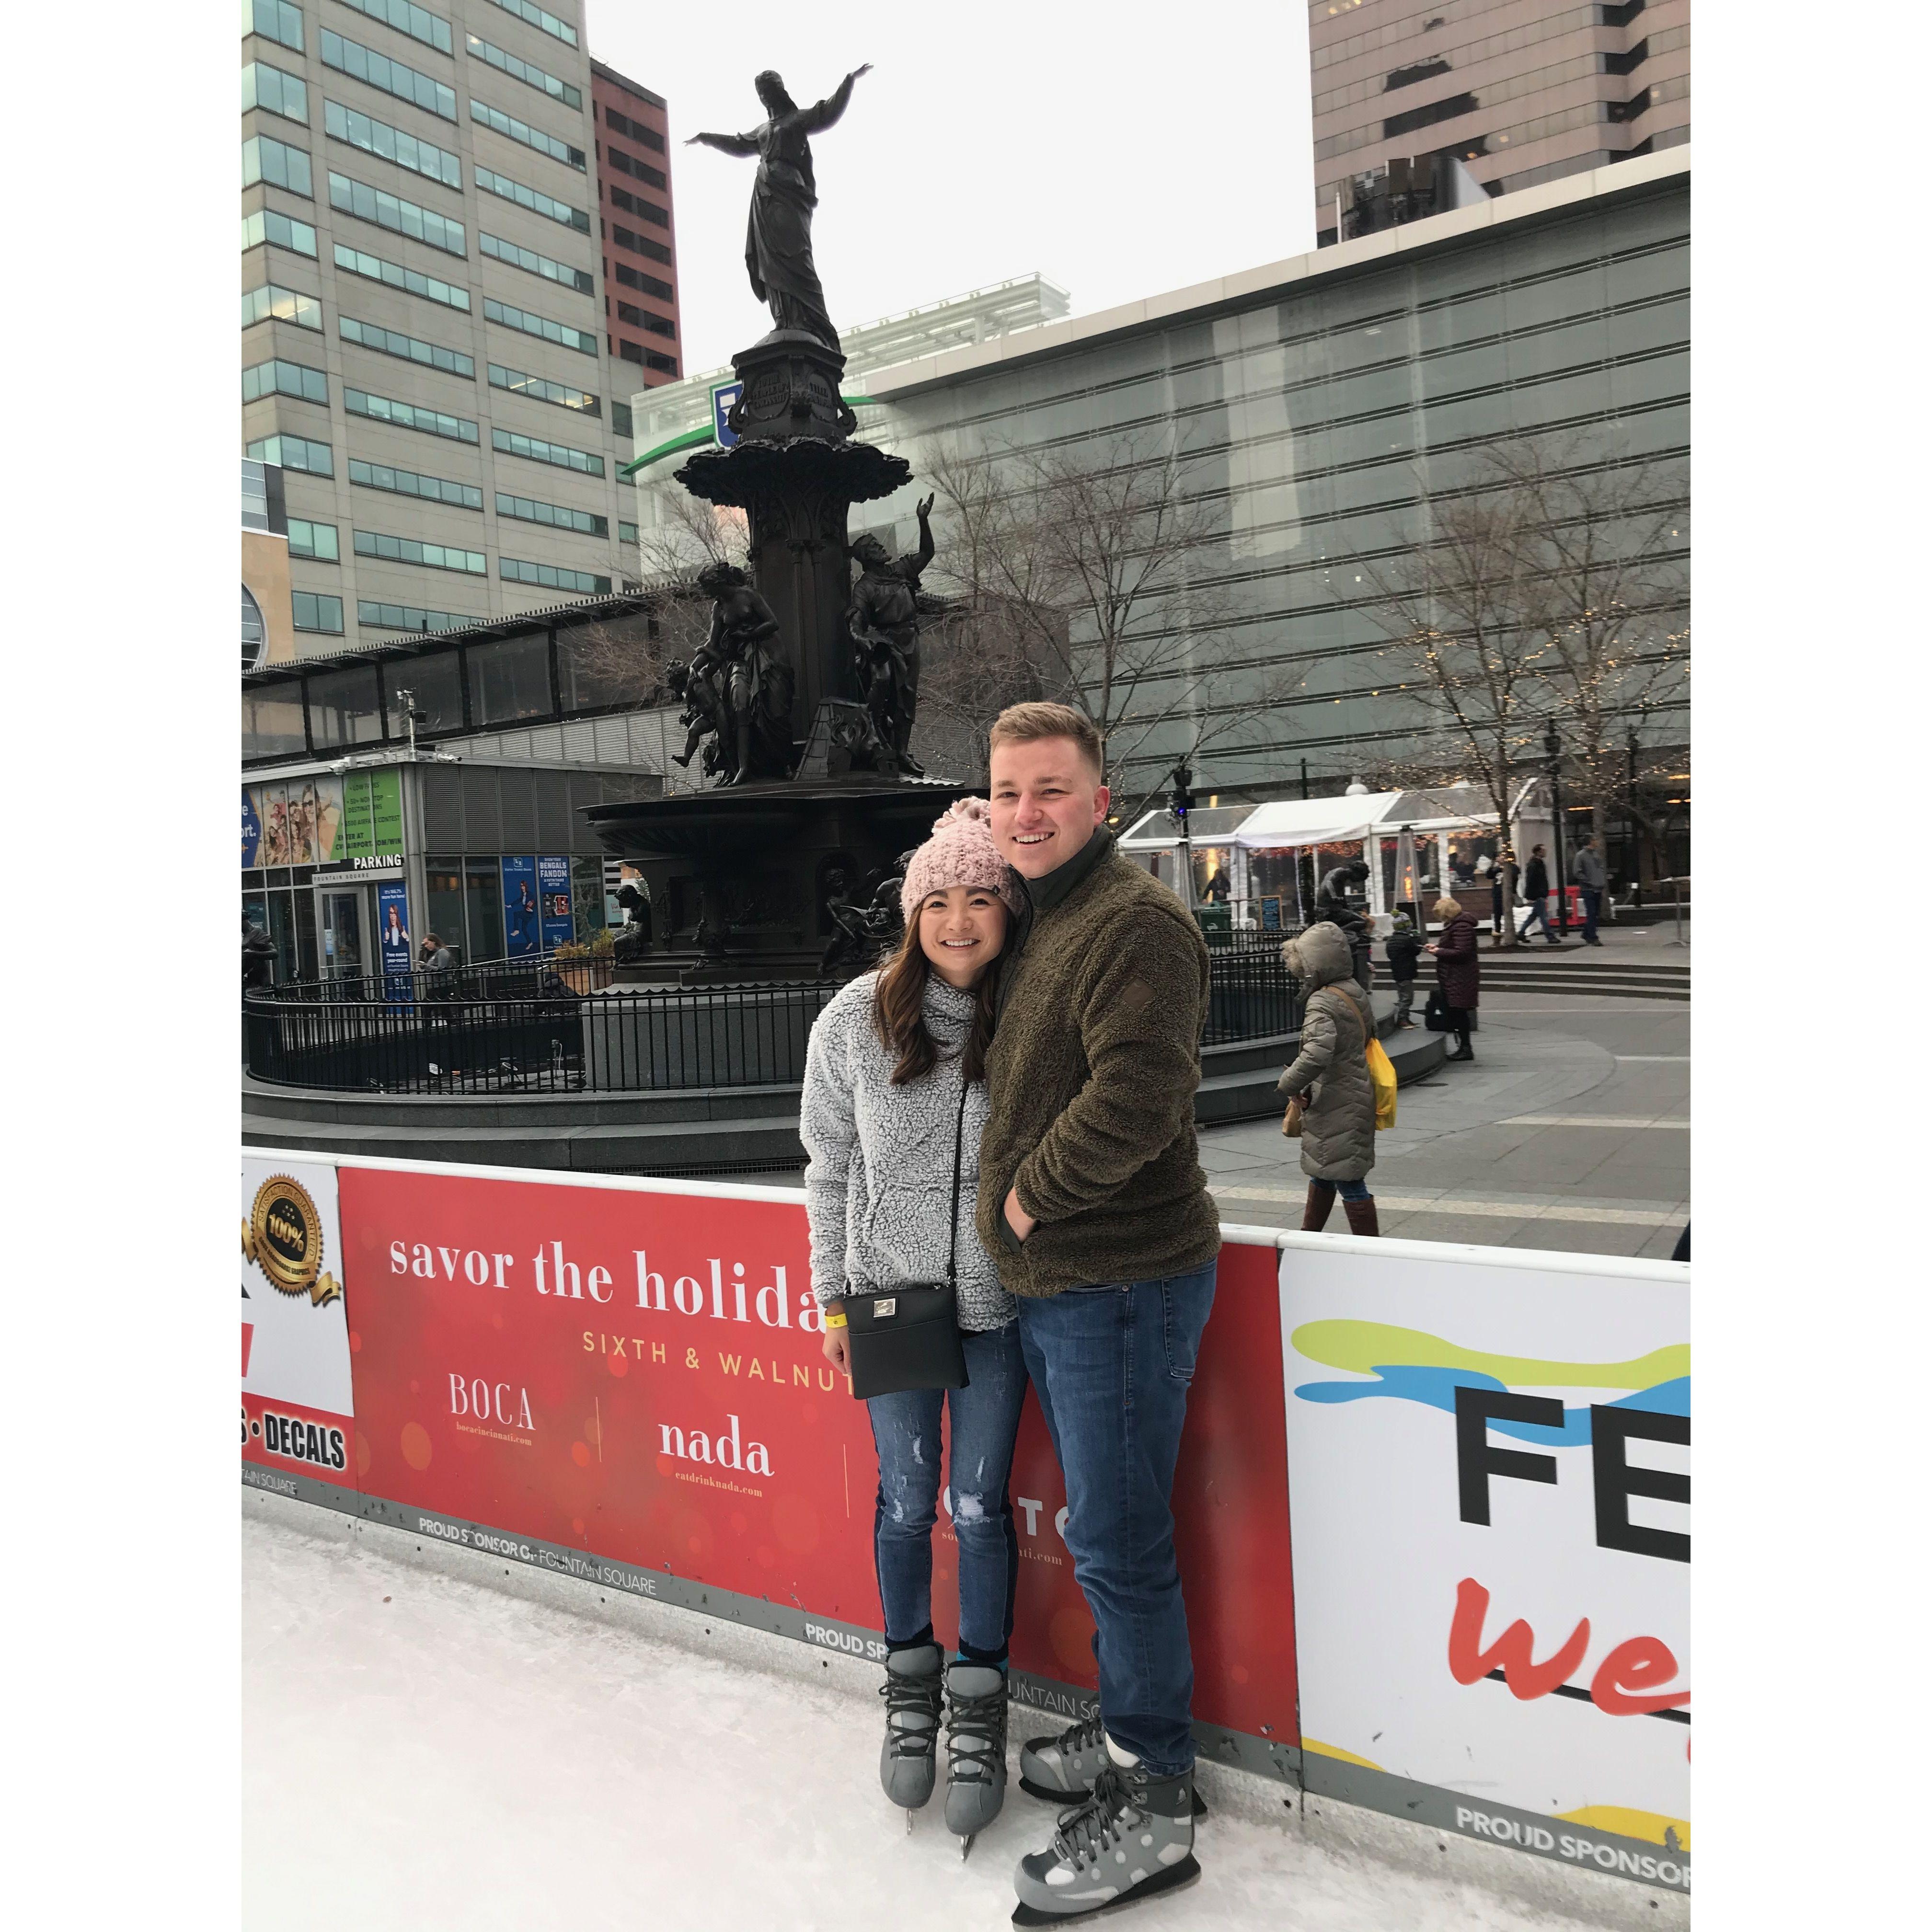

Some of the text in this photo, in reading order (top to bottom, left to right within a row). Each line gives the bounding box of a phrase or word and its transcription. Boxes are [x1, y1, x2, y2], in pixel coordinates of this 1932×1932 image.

[354, 854, 402, 869] PARKING
[269, 1214, 304, 1253] 100%
[390, 1241, 514, 1289] savor
[531, 1240, 614, 1303] the
[583, 1331, 853, 1395] SIXTH & WALNUT
[448, 1373, 537, 1430] BOCA
[264, 1414, 345, 1469] DECALS
[456, 1421, 532, 1446] bocacincinnati.com
[658, 1414, 775, 1477] nada
[261, 1473, 297, 1495] SQUARE
[675, 1472, 763, 1497] eatdrinknada.com
[419, 1517, 460, 1540] PROUD
[461, 1529, 518, 1557] SONSOR
[539, 1550, 601, 1581] FOUNTAIN
[604, 1567, 656, 1596] SQUARE
[805, 1622, 864, 1653] PROUD
[1456, 1806, 1555, 1851] PROUD
